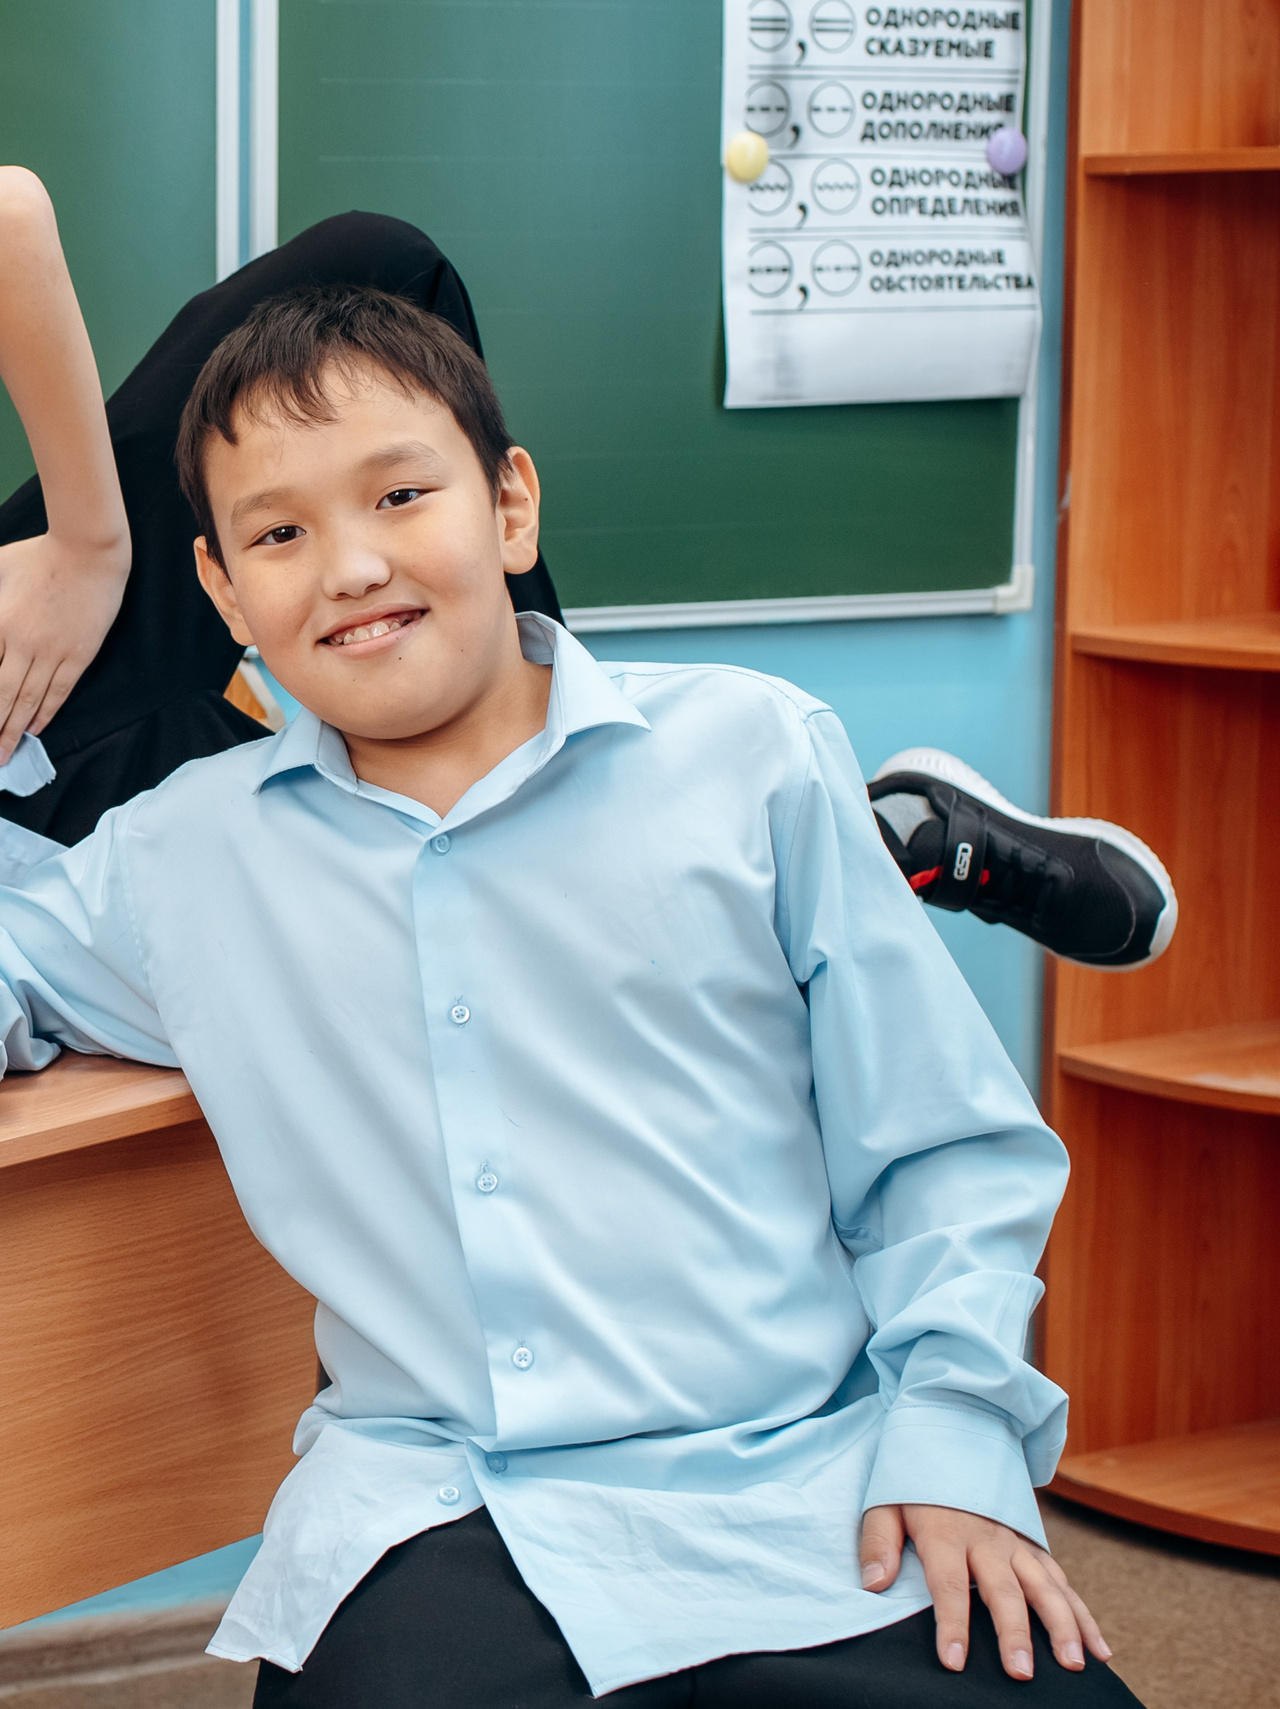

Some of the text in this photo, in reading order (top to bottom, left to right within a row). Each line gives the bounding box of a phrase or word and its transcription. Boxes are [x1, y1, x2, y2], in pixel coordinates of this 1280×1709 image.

[865, 8, 1020, 31] ОДНОРОДНЫЕ
[865, 37, 995, 59] СКАЗУЕМЫЕ
[861, 92, 1016, 113] ОДНОРОДНЫЕ
[860, 120, 1006, 143] ДОПОЛНЕНИ
[871, 197, 1021, 218] ОПРЕДЕЛЕНИЯ
[869, 249, 1006, 267] ОДНОРОДНЫЕ
[869, 274, 1035, 292] ОБСТОЯТЕЛЬСТВА
